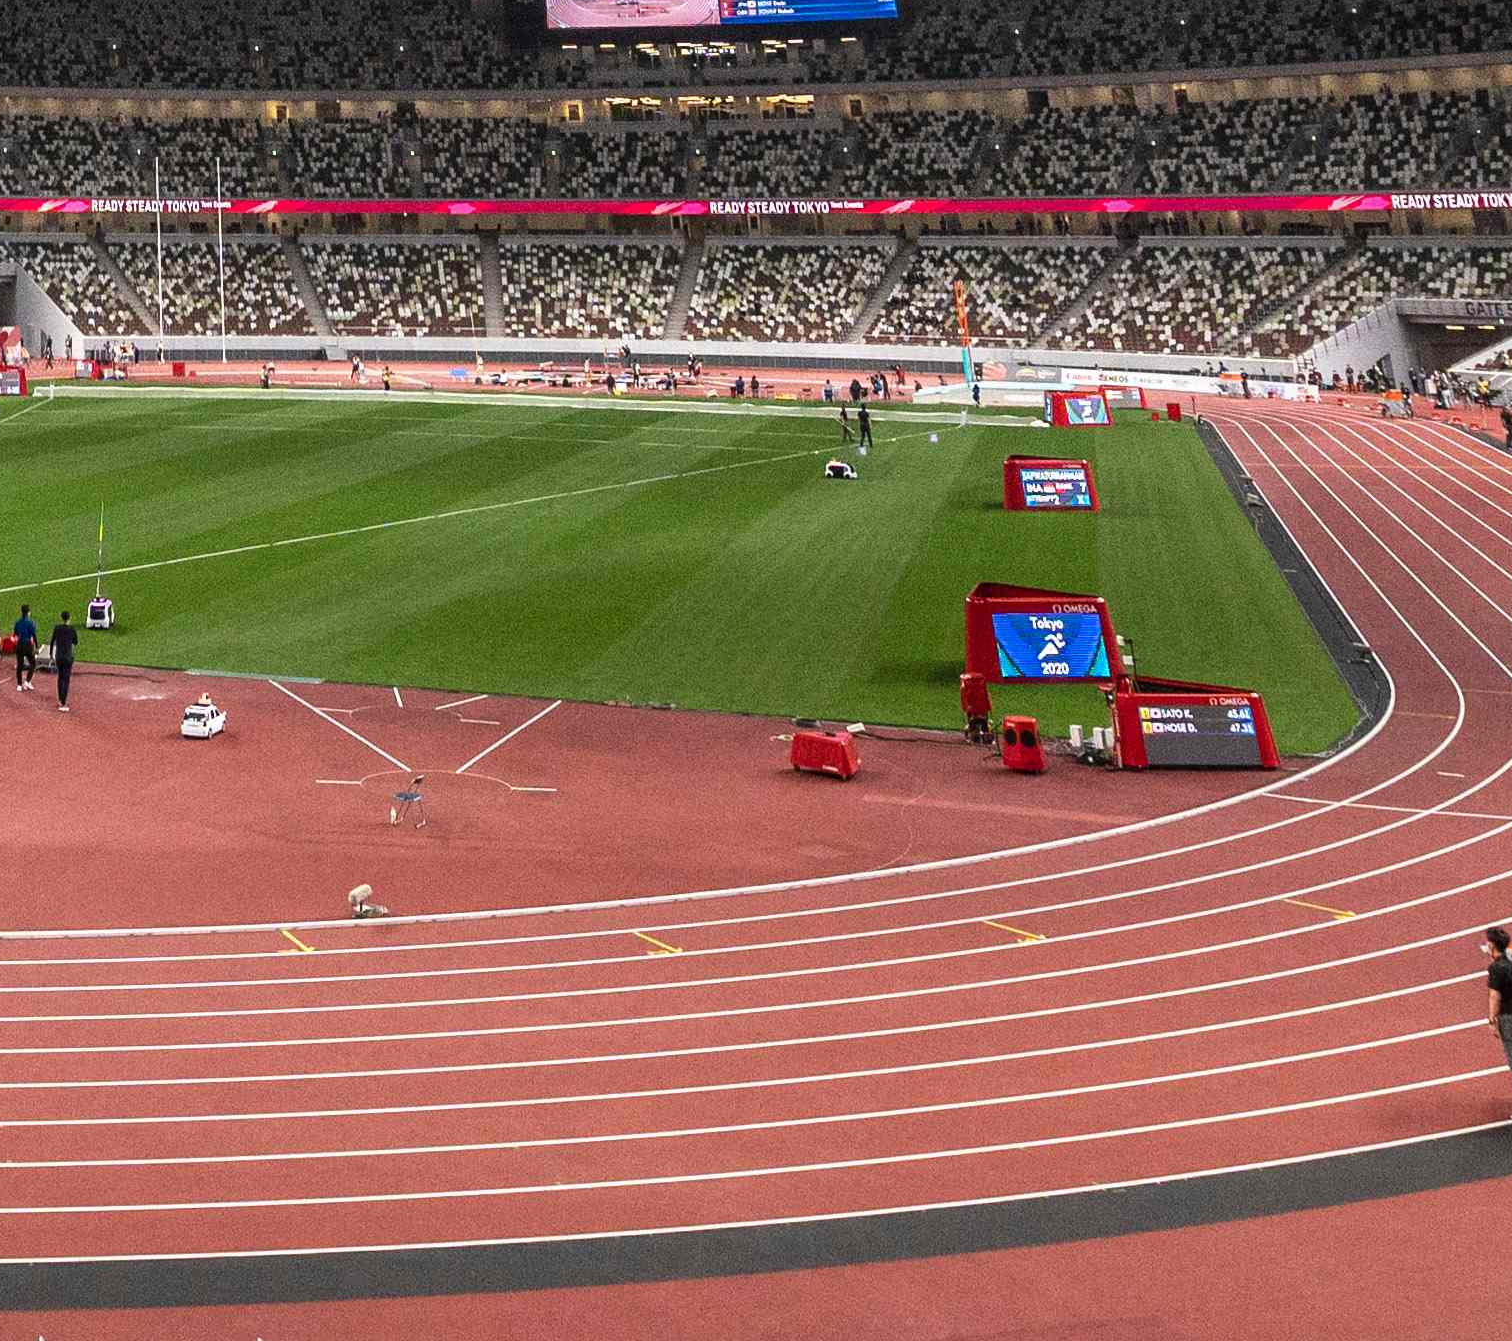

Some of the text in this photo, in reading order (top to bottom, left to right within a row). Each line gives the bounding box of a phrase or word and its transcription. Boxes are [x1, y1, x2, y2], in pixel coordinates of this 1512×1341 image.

[92, 199, 124, 213] READY
[126, 199, 165, 213] STEADY
[166, 200, 200, 213] TOKYO
[710, 201, 746, 213] READY
[748, 201, 791, 213] STEADY
[792, 201, 829, 213] TOKYO
[1392, 194, 1432, 209] READY
[1432, 193, 1480, 209] STEADY
[1466, 301, 1504, 317] GATE
[1080, 482, 1086, 493] 7
[1063, 604, 1097, 613] OMEGA
[1029, 617, 1064, 631] Tokyo
[1041, 662, 1070, 675] 2020
[1219, 697, 1250, 705] OMEGA
